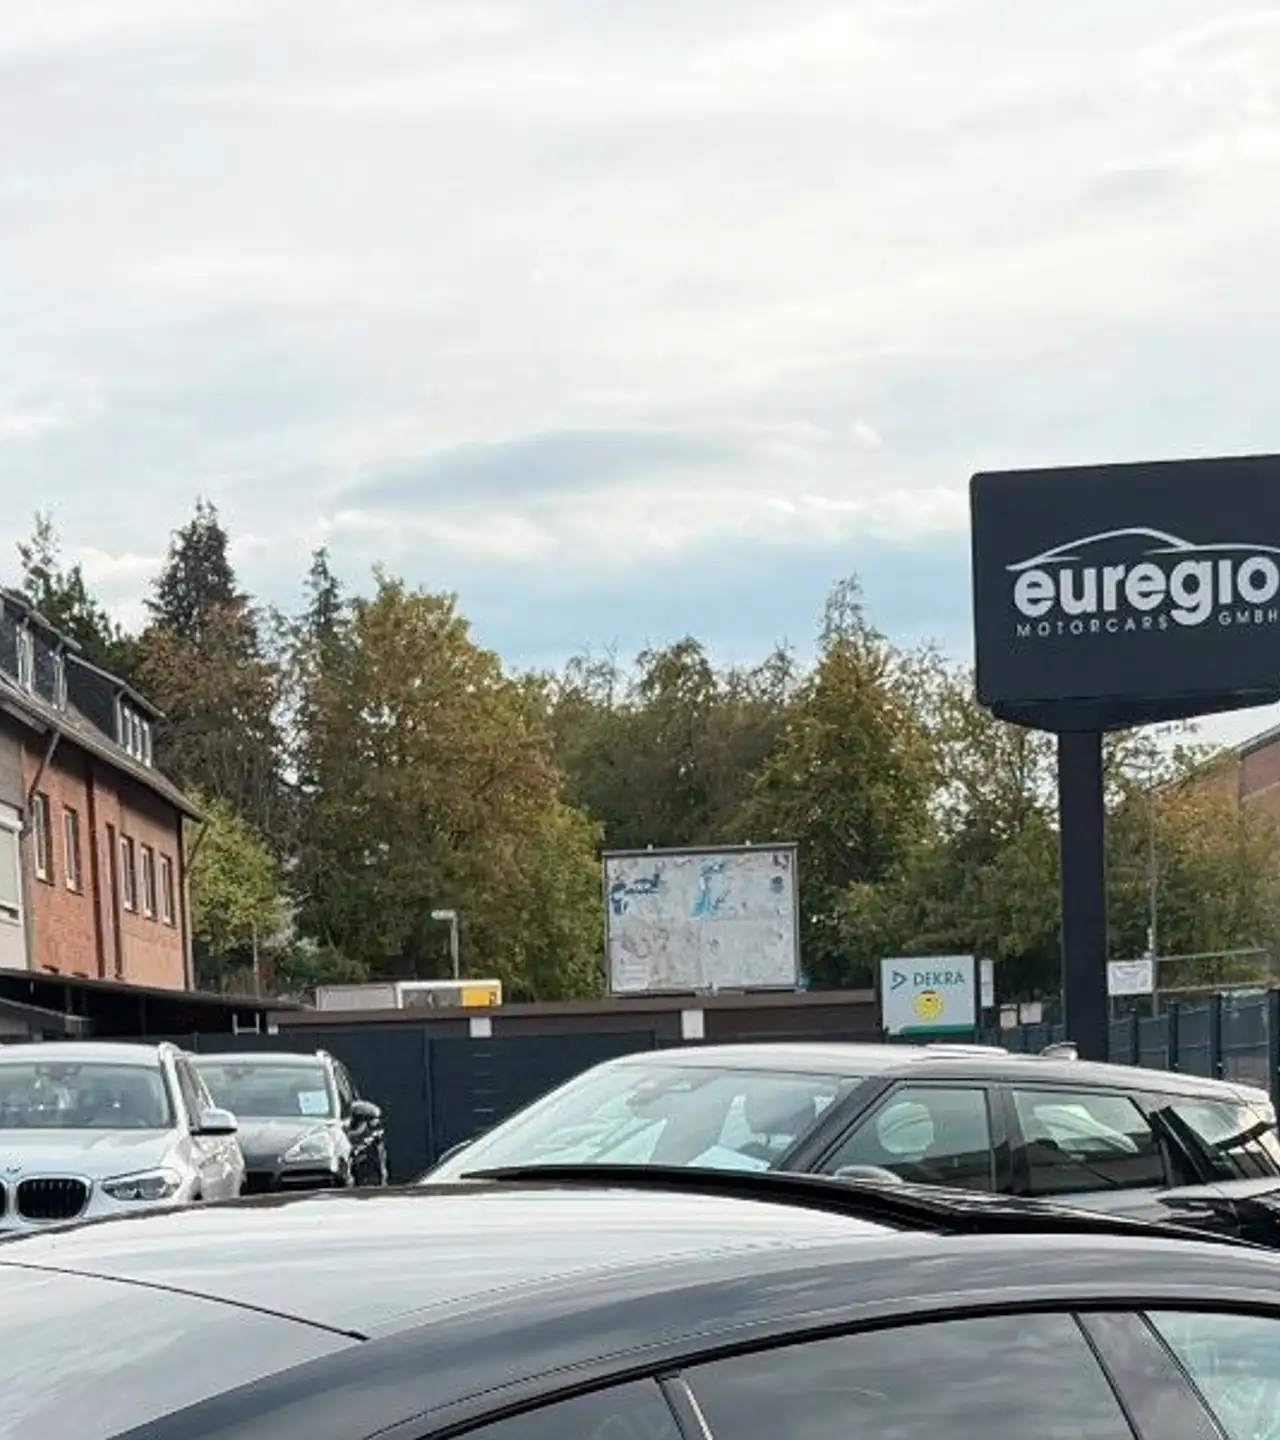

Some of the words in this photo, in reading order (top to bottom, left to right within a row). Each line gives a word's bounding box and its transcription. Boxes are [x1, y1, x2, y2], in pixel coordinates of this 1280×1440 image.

[1013, 555, 1280, 626] euregio
[1016, 614, 1170, 638] MOTORCARS
[1218, 609, 1280, 626] GMBH
[912, 970, 966, 987] DEKRA
